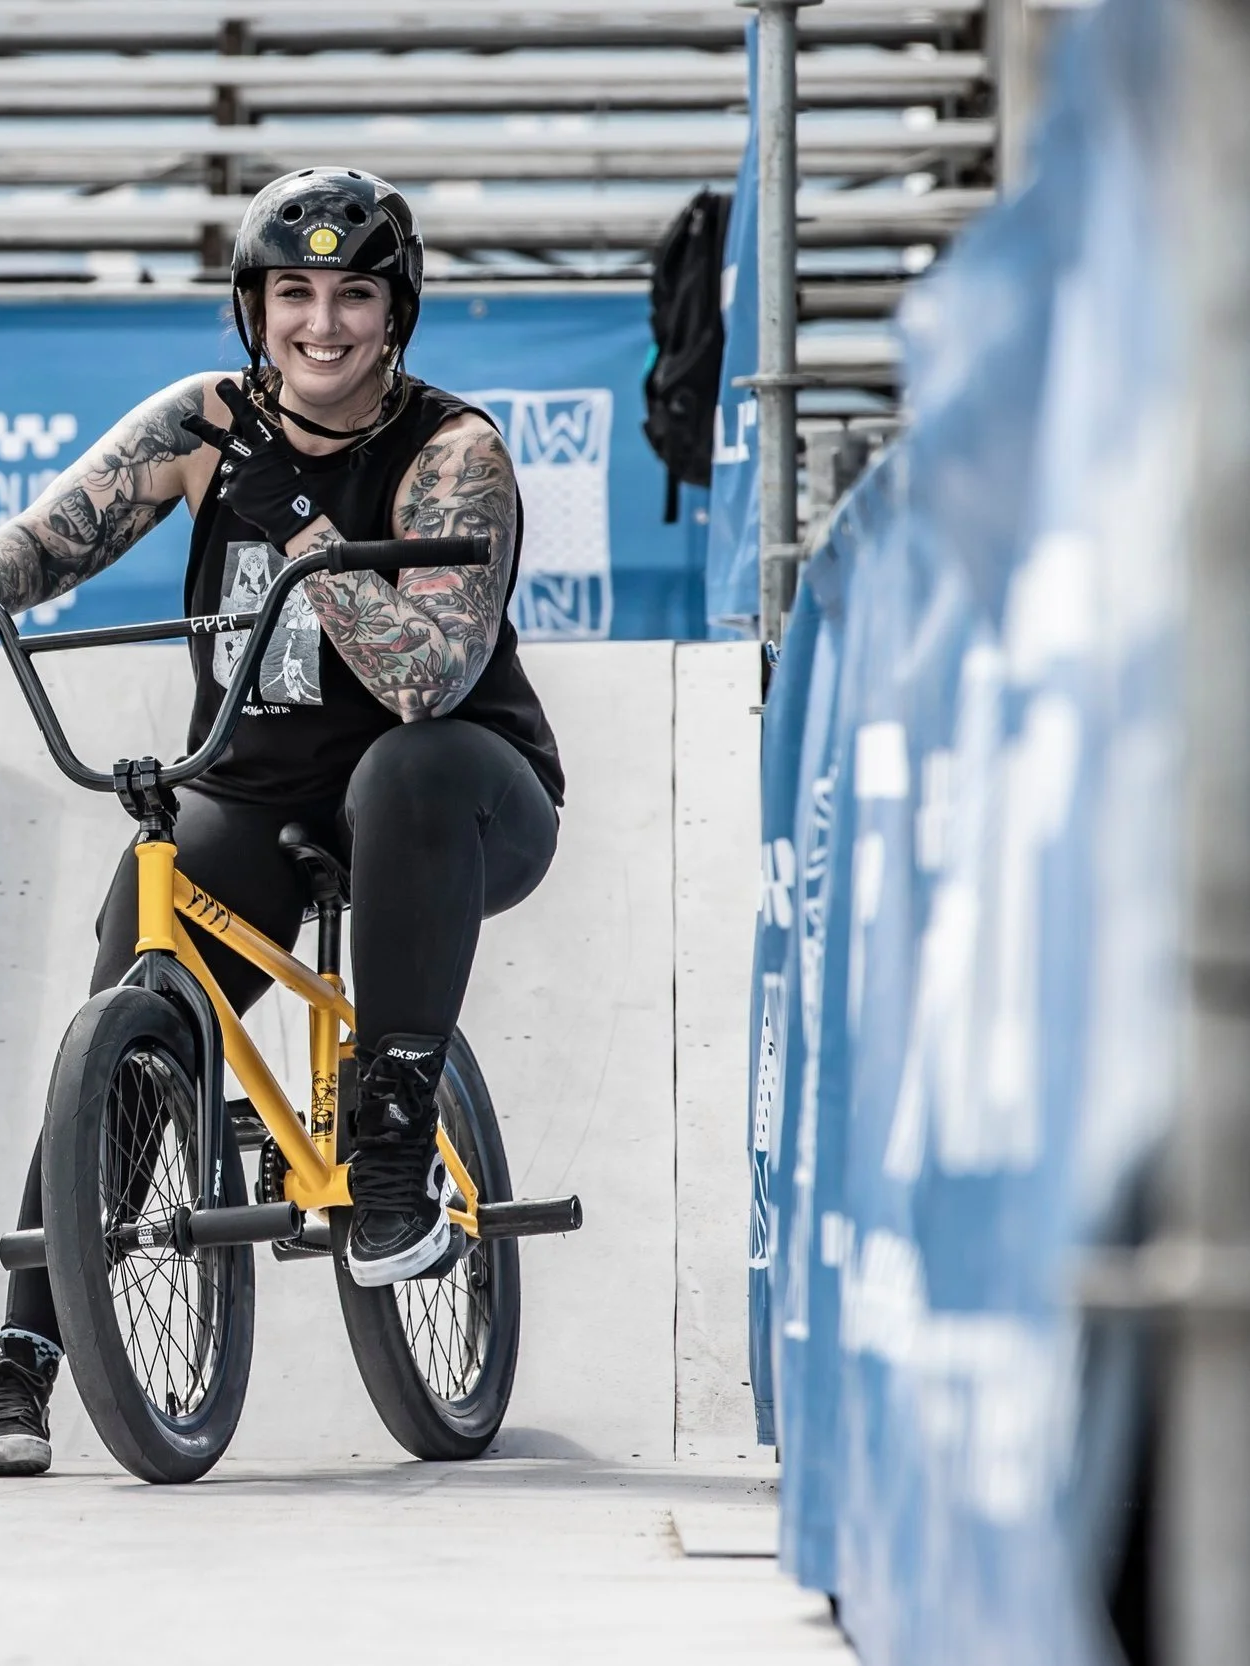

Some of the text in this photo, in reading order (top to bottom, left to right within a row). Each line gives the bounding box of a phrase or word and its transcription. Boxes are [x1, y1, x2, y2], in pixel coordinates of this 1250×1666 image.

[302, 222, 347, 237] DON'T WORRY
[317, 255, 342, 263] HAPPY
